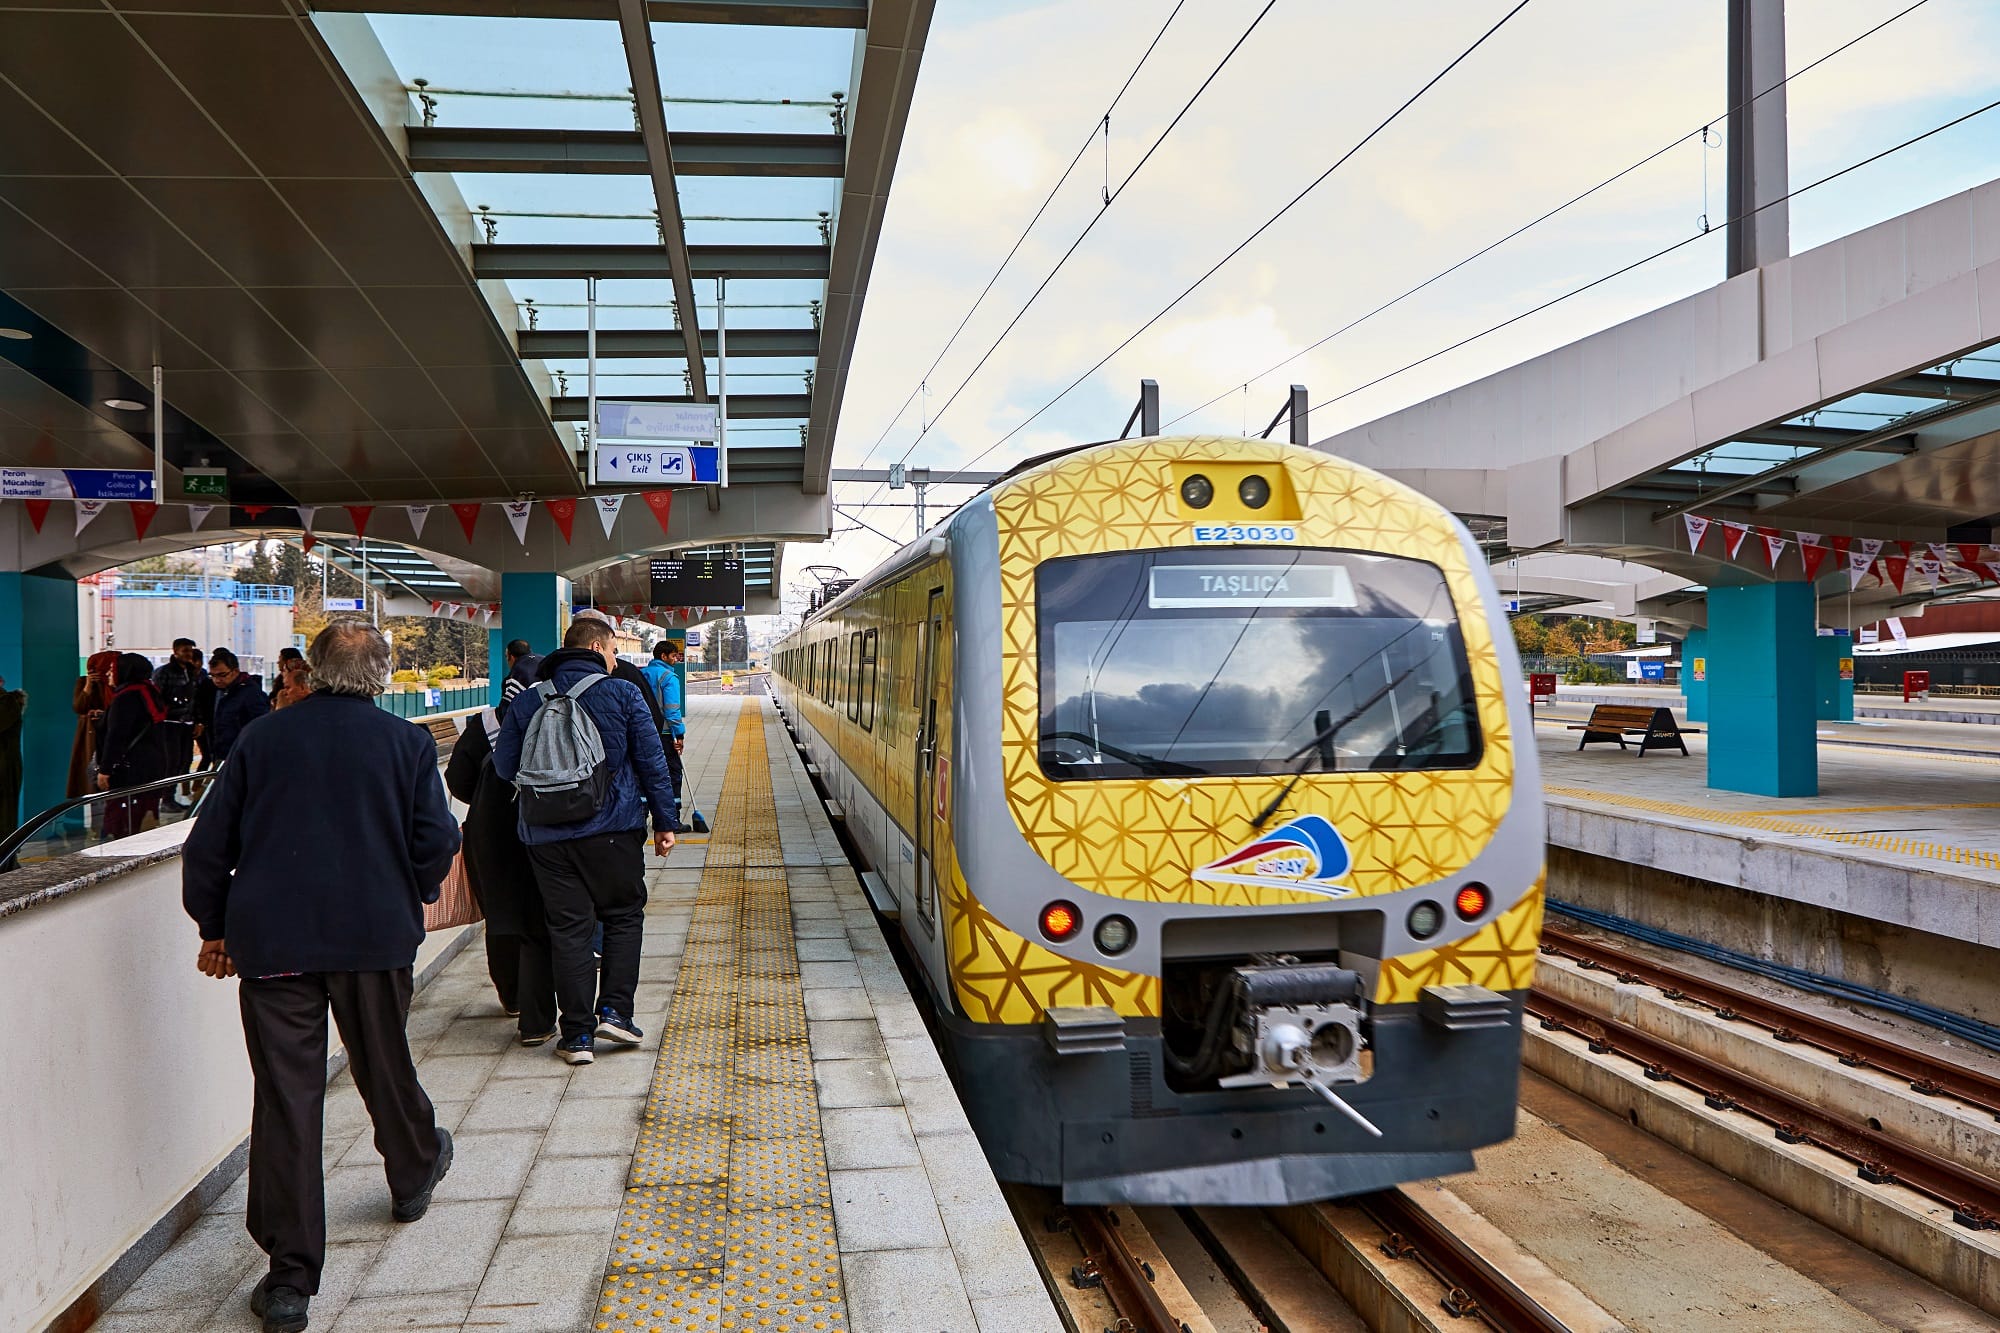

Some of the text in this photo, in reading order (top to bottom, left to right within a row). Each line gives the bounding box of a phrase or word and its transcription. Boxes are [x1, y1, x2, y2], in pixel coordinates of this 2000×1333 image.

[626, 453, 652, 463] ÇIKIŞ
[631, 465, 648, 474] Exit
[1194, 527, 1295, 541] E23030
[1199, 575, 1289, 596] TAŞLICA
